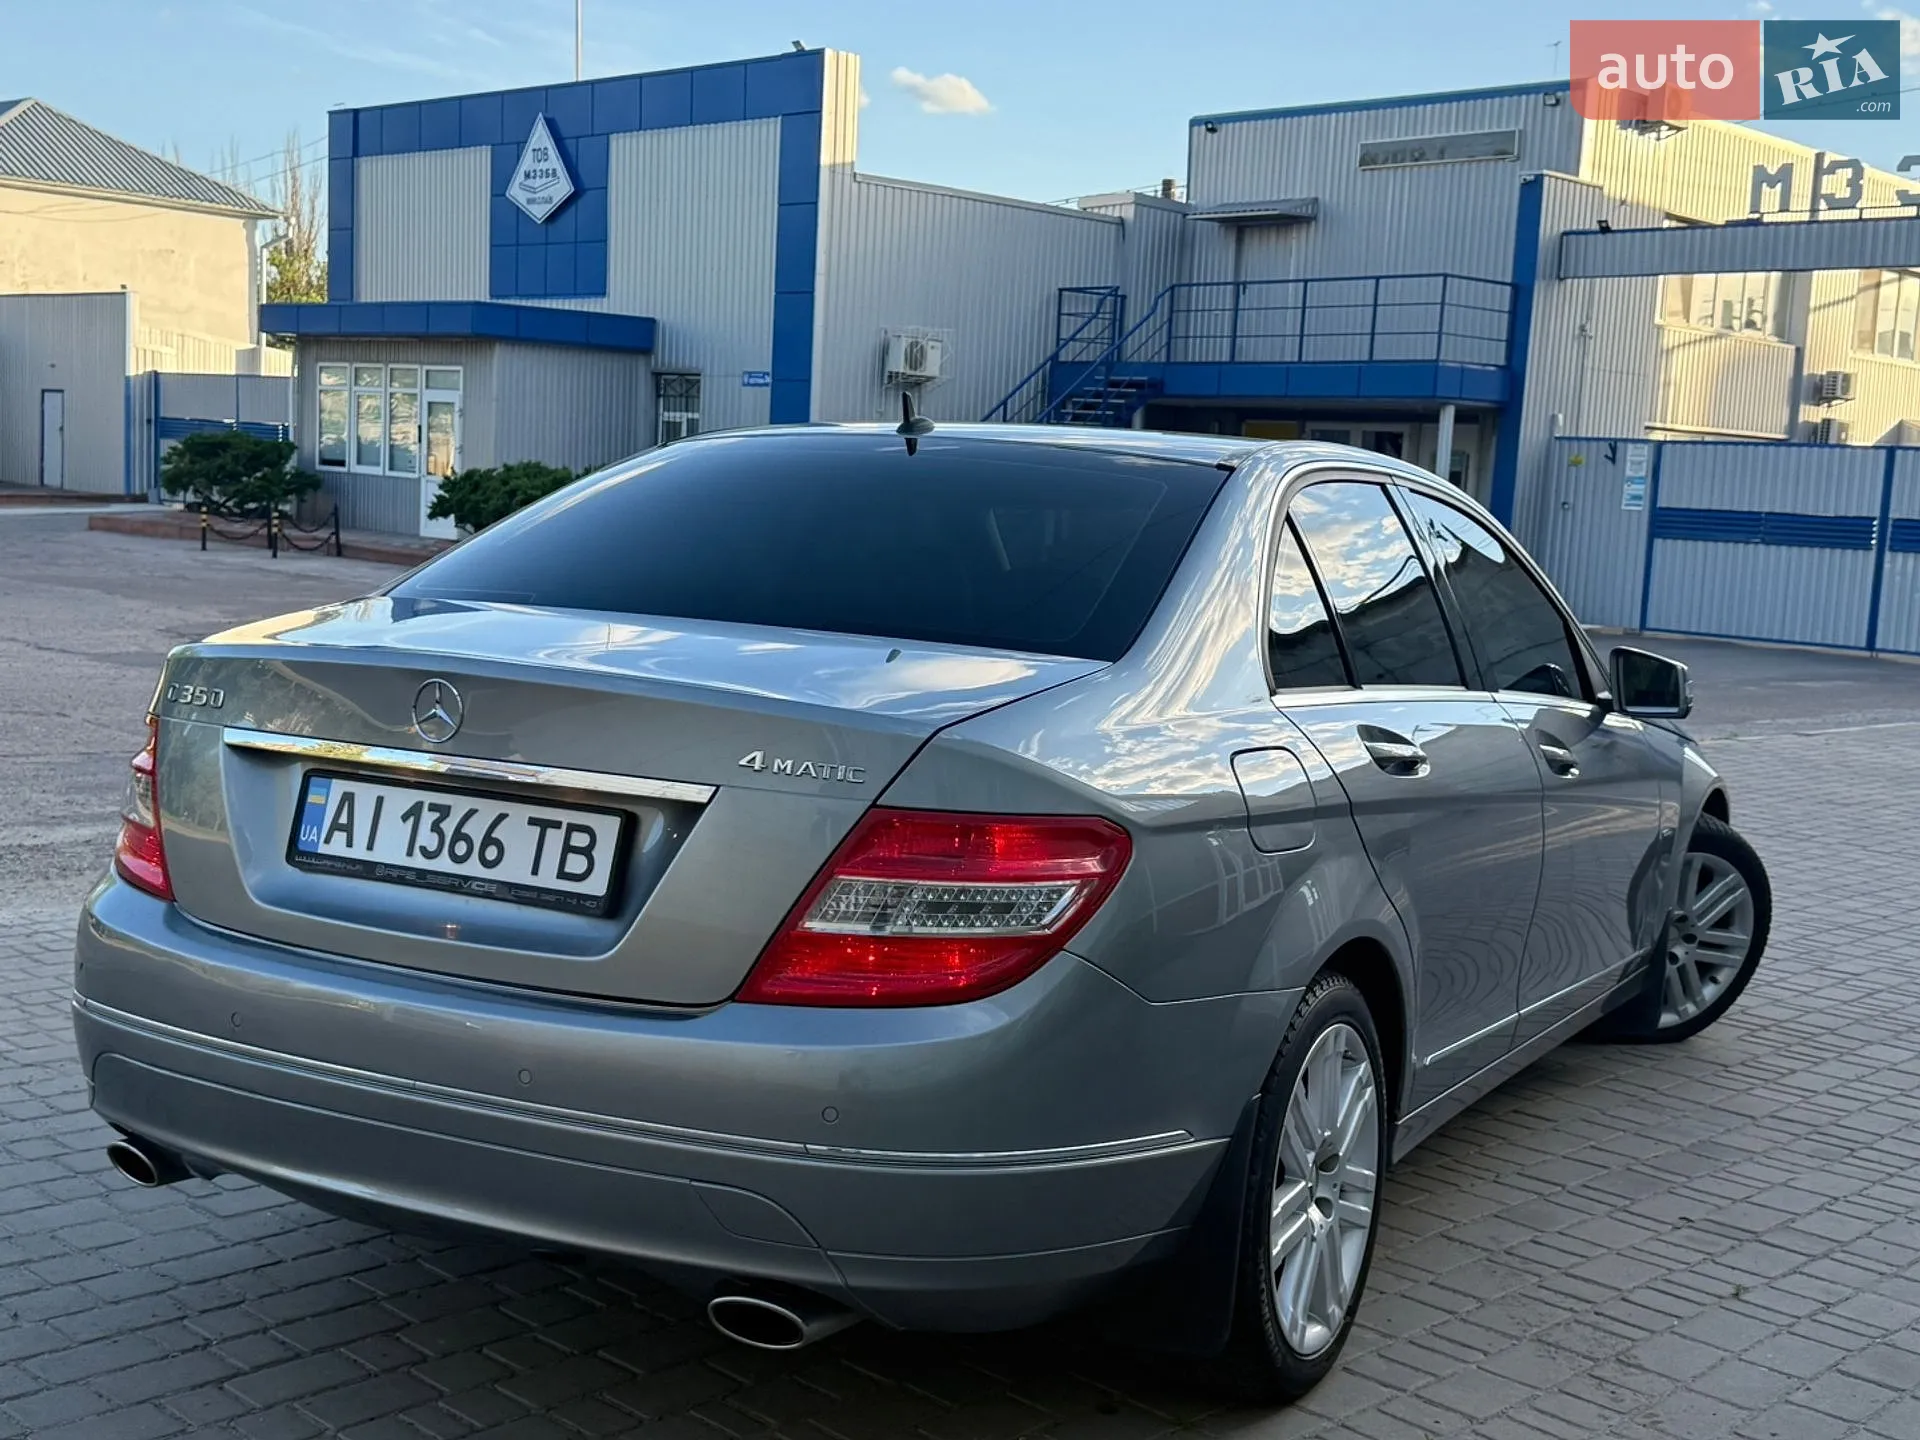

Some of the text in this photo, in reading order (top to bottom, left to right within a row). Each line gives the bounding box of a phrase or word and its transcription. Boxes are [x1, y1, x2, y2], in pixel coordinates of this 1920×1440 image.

[300, 823, 318, 843] UA
[323, 791, 598, 882] AI 1366 TB
